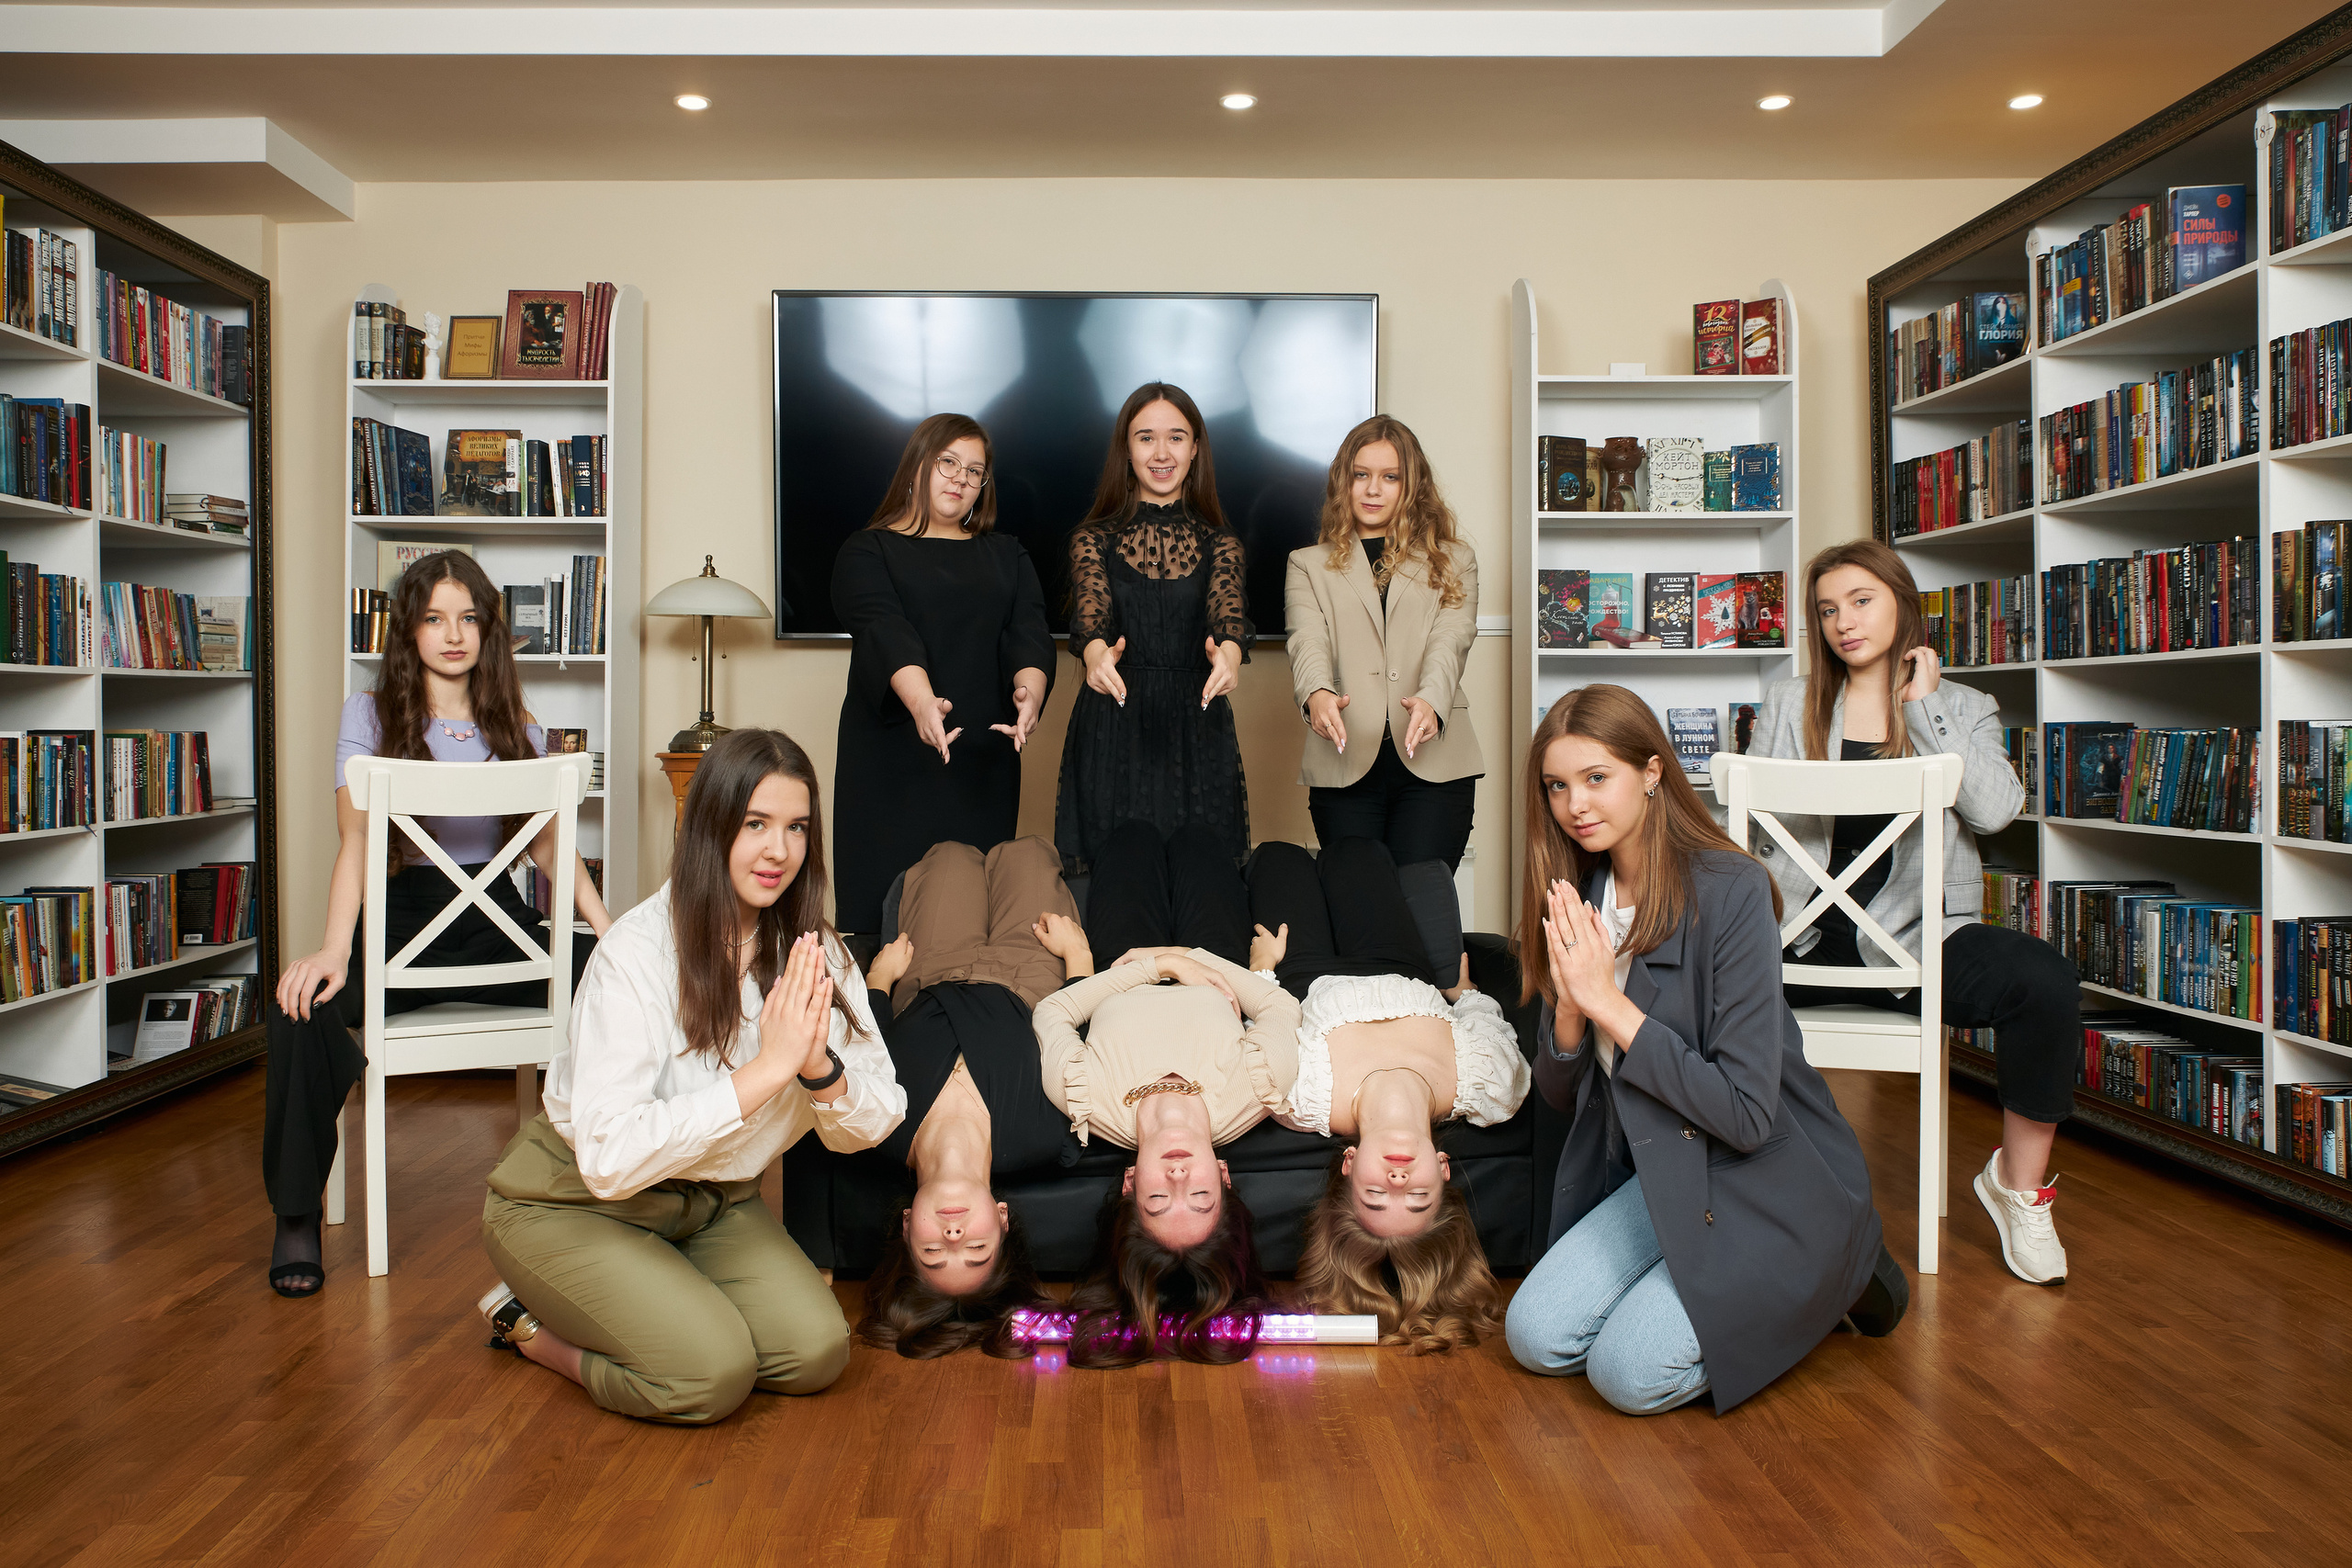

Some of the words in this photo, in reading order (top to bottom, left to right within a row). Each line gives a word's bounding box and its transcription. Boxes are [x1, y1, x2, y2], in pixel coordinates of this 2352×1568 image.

[2255, 124, 2274, 141] 18+
[2183, 218, 2215, 231] СИЛЫ
[2183, 230, 2238, 245] ПРИРОДЫ
[51, 239, 63, 269] ЖИЗНЬ
[63, 244, 75, 274] ЖИЗНЬ
[53, 273, 64, 323] МАЛЕНЬКАЯ
[65, 277, 76, 327] МАЛЕНЬКАЯ
[1703, 305, 1731, 322] 12
[1978, 329, 2024, 341] ГЛОРИЯ
[2318, 378, 2324, 388] ИЗ
[2331, 381, 2337, 392] ИЗ
[2318, 389, 2324, 405] МЫ
[2331, 394, 2337, 410] МЫ
[1663, 452, 1690, 461] КЕЙТ
[1656, 461, 1699, 470] МОРТОН
[2183, 545, 2191, 588] СТРЕЛОК
[1674, 722, 1713, 731] ЖЕНЩИНА
[1681, 734, 1714, 742] ЛУННОМ
[1681, 746, 1710, 754] СВЕТЕ
[2155, 765, 2164, 781] ШАНС
[2288, 796, 2296, 833] АРЕНА
